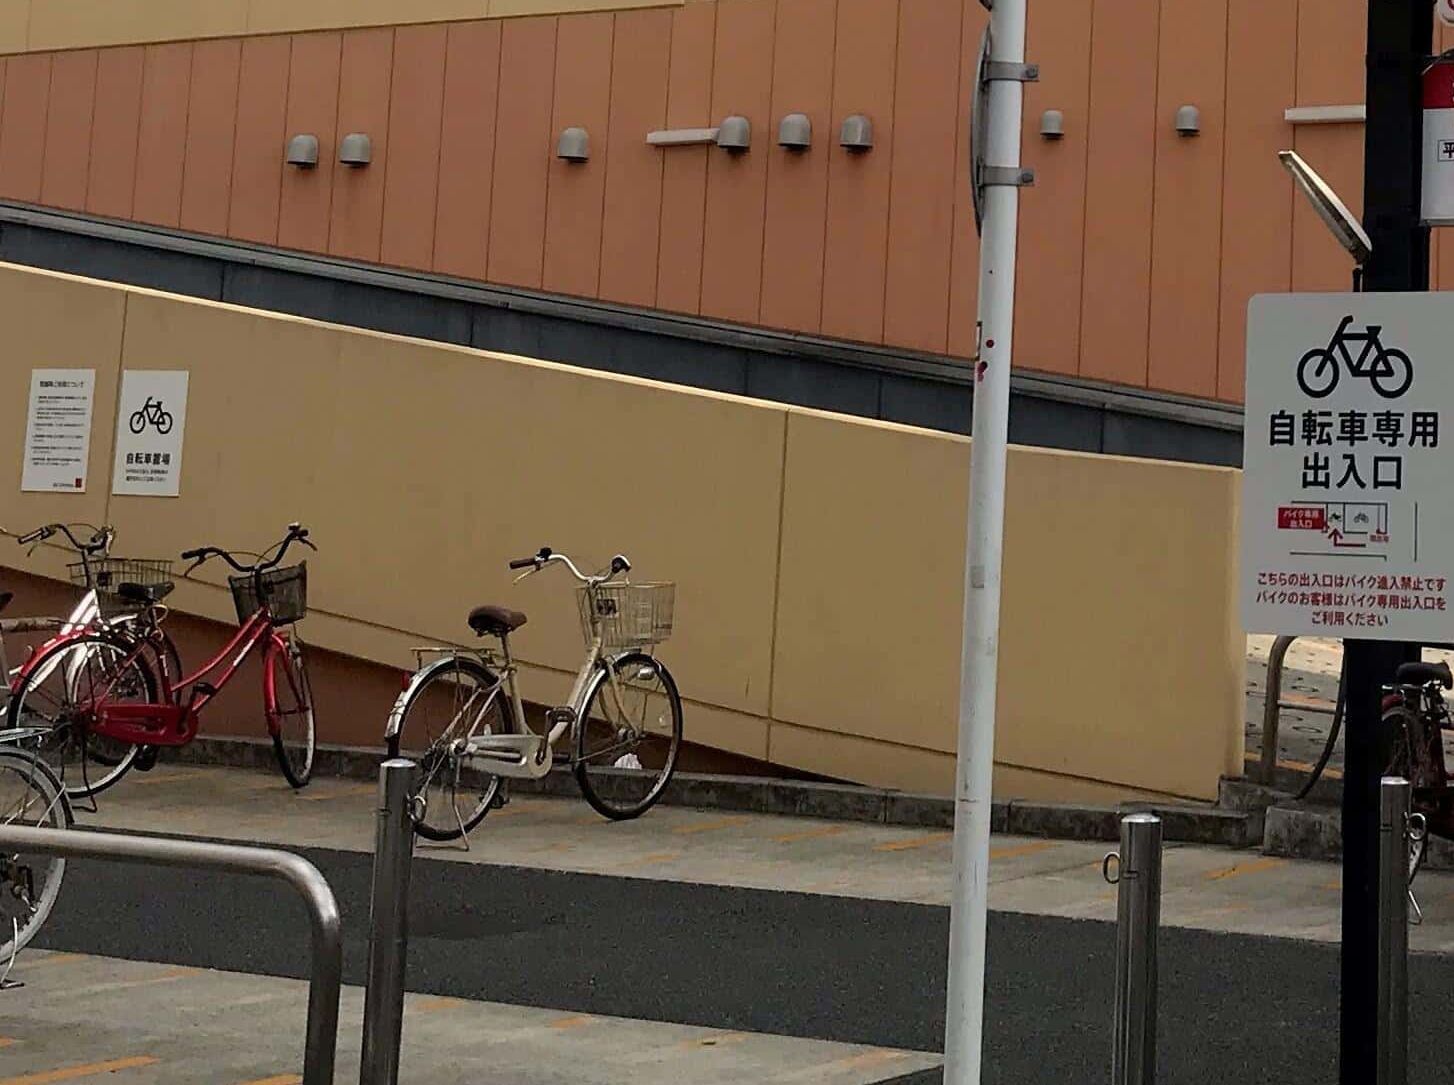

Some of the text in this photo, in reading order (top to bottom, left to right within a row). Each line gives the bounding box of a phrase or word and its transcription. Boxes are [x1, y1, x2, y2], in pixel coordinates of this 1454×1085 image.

[1269, 410, 1439, 448] 自転車専用
[1302, 452, 1402, 490] 出入口
[1257, 572, 1446, 592] こちらの出入口はバイク進入禁止です
[1256, 591, 1446, 611] バイクのお客様はバイク専用出入口を
[1312, 611, 1388, 627] ご利用ください
